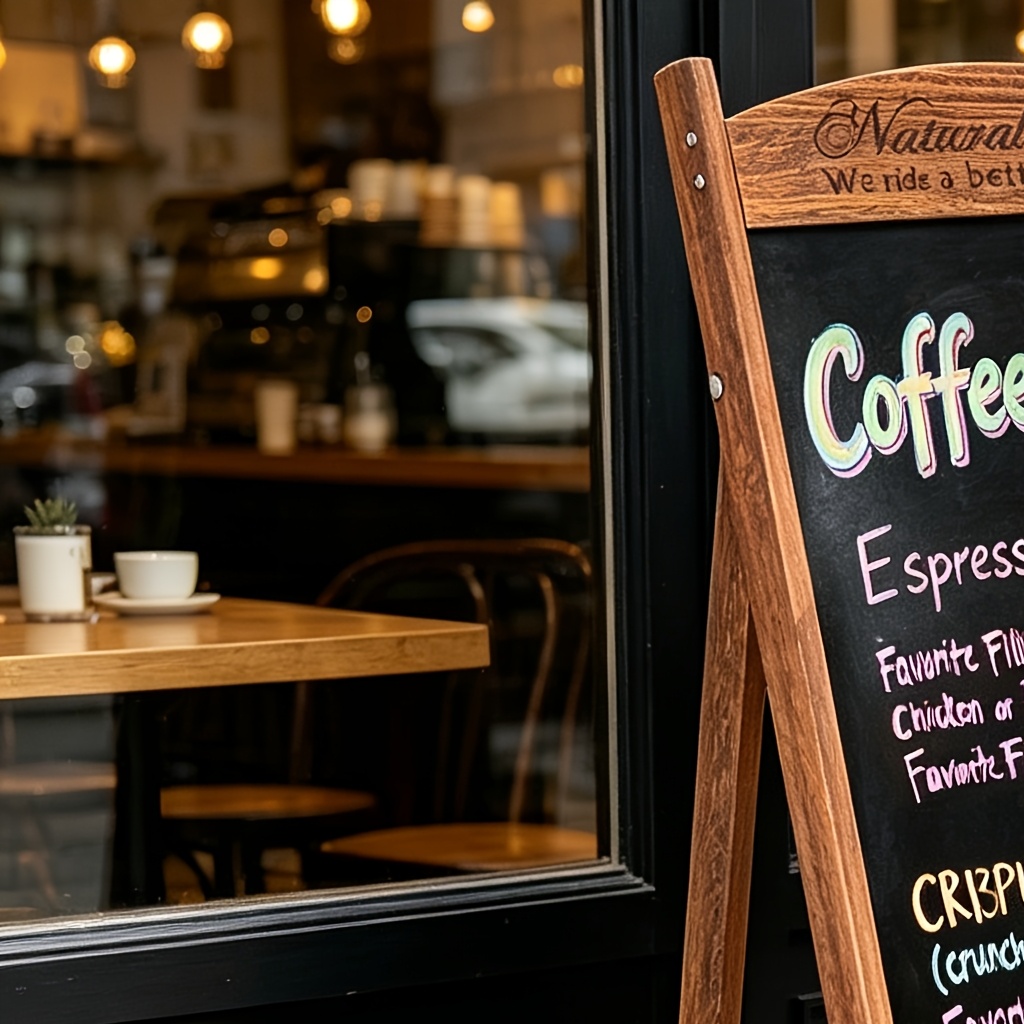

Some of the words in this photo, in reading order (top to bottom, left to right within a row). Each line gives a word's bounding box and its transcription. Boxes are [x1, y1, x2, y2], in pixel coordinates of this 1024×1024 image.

[821, 167, 876, 195] We
[939, 171, 955, 189] a
[875, 639, 979, 692] Favorite
[994, 698, 1013, 721] or
